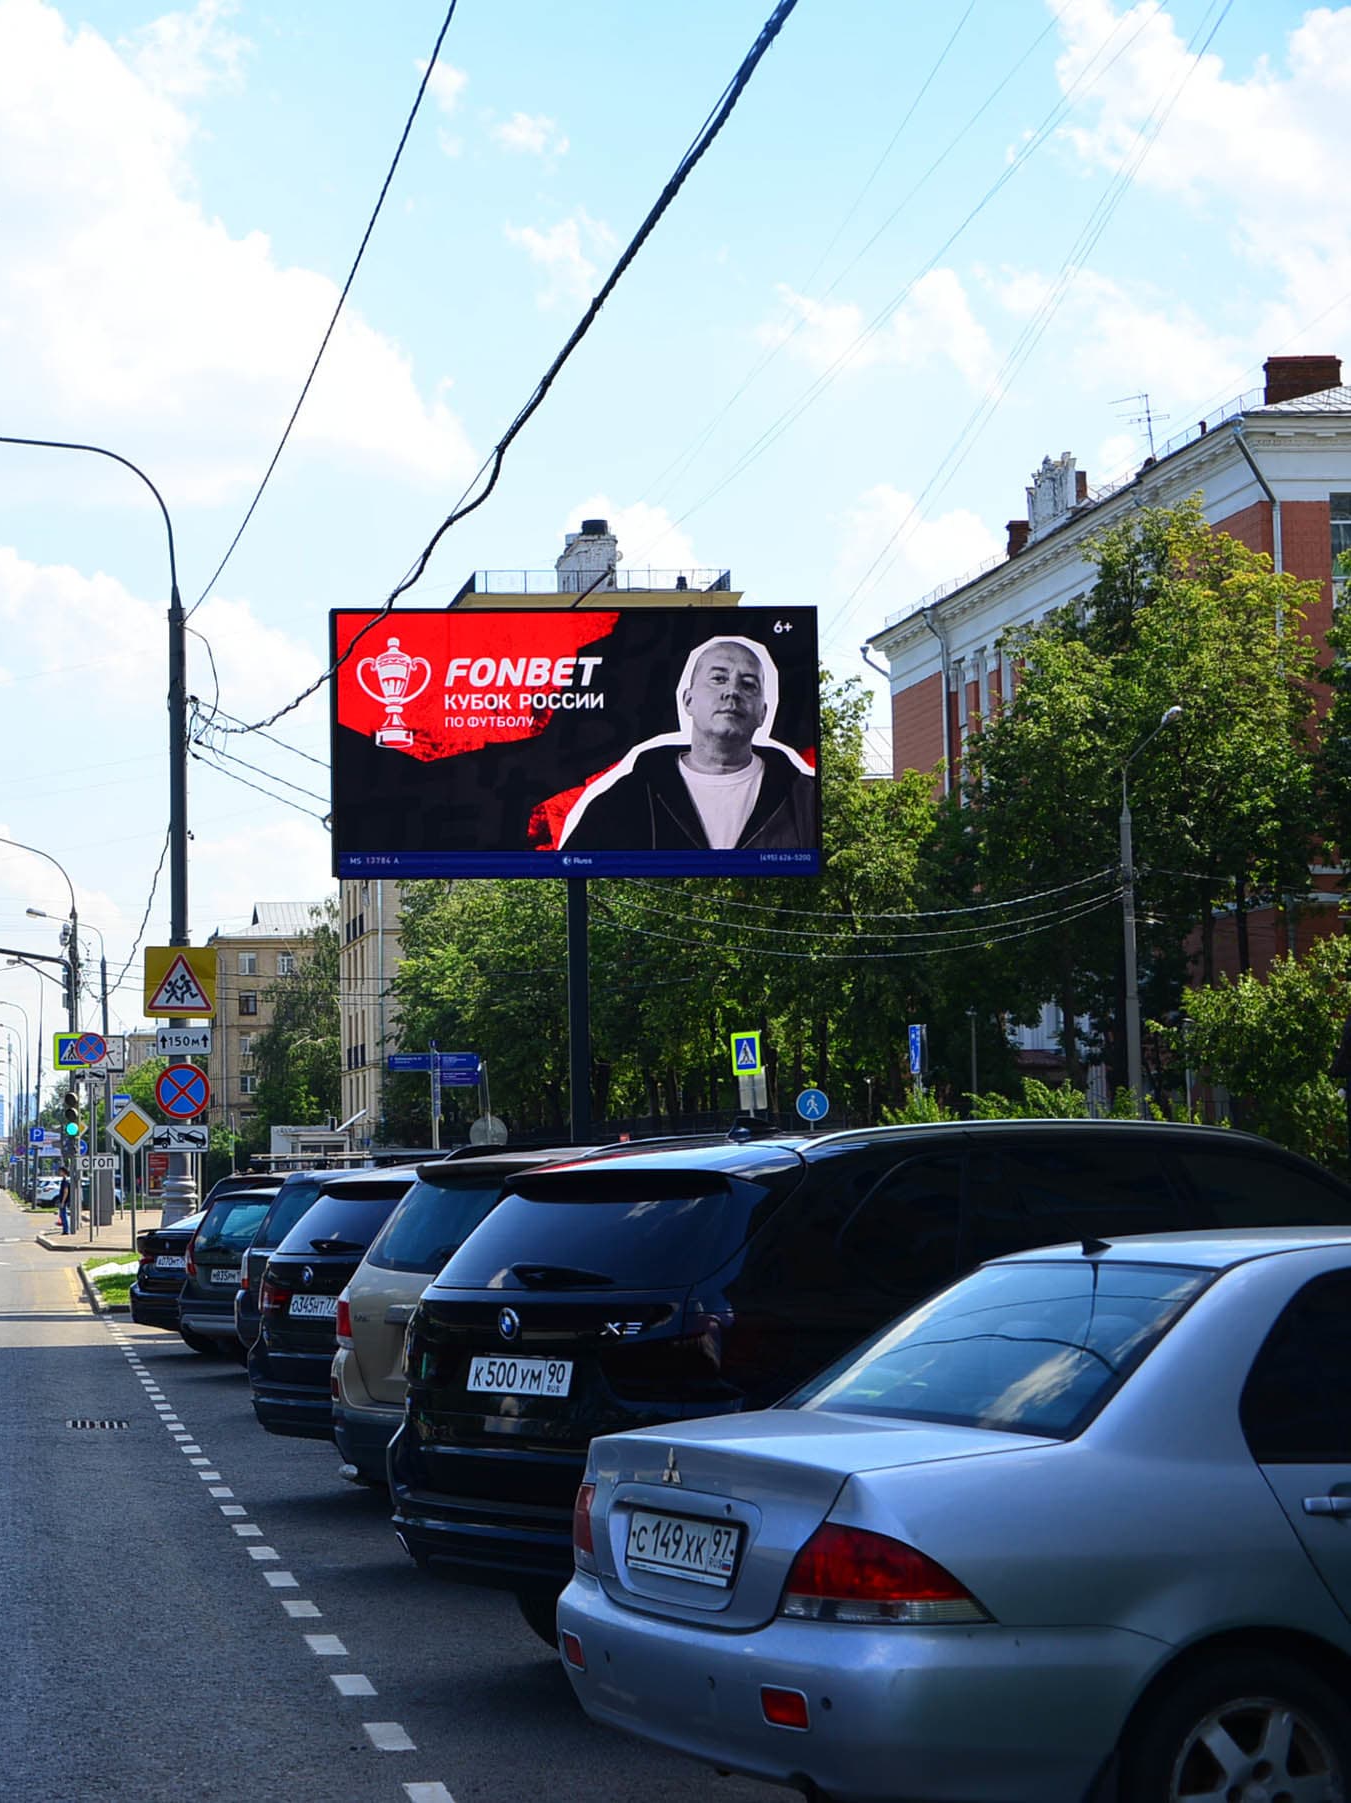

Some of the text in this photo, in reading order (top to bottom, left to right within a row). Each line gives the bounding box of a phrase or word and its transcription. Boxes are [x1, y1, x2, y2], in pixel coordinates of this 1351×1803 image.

[773, 619, 793, 634] 6+
[444, 657, 603, 688] FONBET
[444, 692, 604, 710] КУБОК РОССИИ
[444, 715, 535, 728] ПО ФУТБОЛУ
[547, 1363, 566, 1384] 90
[712, 1529, 732, 1558] 97
